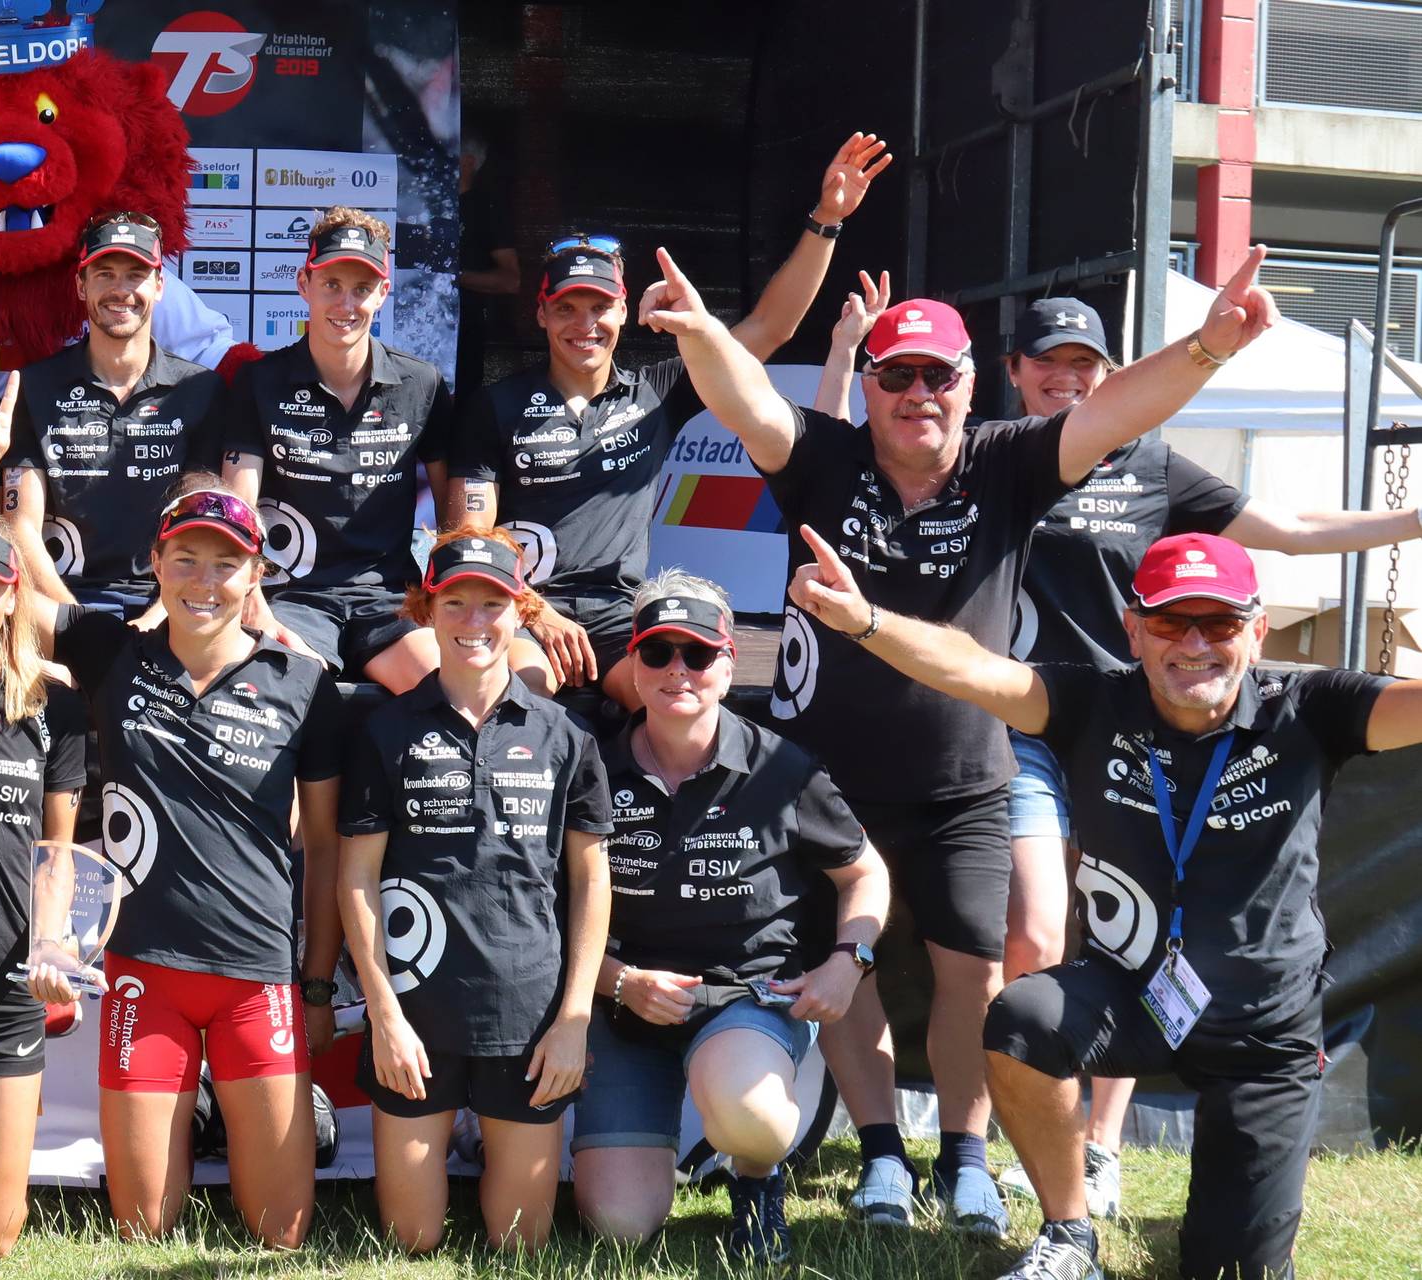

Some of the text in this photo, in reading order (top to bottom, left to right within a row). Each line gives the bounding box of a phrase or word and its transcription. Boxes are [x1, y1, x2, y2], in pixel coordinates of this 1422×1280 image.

[272, 33, 326, 46] triathlon
[265, 46, 333, 57] düsseldorf
[274, 58, 320, 76] 2019
[279, 169, 336, 189] Bitburger
[204, 219, 228, 229] PASS
[260, 272, 295, 280] SPORTS
[274, 264, 297, 273] ultra
[279, 402, 326, 413] EJOT TEAM
[540, 404, 565, 413] TEAM
[271, 424, 313, 442] Krombacher
[351, 433, 412, 445] LINDENSCHMIDT
[617, 428, 639, 448] SIV
[66, 443, 109, 452] schmelzer
[149, 444, 174, 459] SIV
[534, 449, 579, 460] schmelzer
[288, 455, 320, 464] medien
[374, 451, 399, 466] SIV
[534, 457, 567, 467] medien
[142, 464, 179, 481] gicom
[366, 472, 403, 487] gicom
[5, 488, 19, 511] 3
[466, 493, 486, 512] 5
[1096, 499, 1128, 514] SIV
[1089, 519, 1136, 534] gicom
[132, 675, 175, 701] Krombacher
[233, 729, 265, 748] SIV
[433, 746, 460, 755] TEAM
[223, 749, 271, 771] gicom
[403, 775, 451, 790] Krombacher
[0, 785, 29, 804] SIV
[1231, 777, 1267, 804] SIV
[423, 797, 473, 808] schmelzer
[520, 798, 546, 816] SIV
[423, 806, 459, 816] medien
[624, 806, 655, 816] TEAM
[1230, 800, 1292, 831] gicom
[512, 824, 548, 839] gicom
[684, 832, 737, 844] UMWELTSERVICE
[684, 838, 761, 852] LINDENSCHMIDT
[708, 860, 742, 876] SIV
[699, 883, 754, 901] gicom
[108, 998, 121, 1047] medien
[1144, 993, 1179, 1040] AUSWEIS
[120, 1003, 139, 1072] schmelzer
